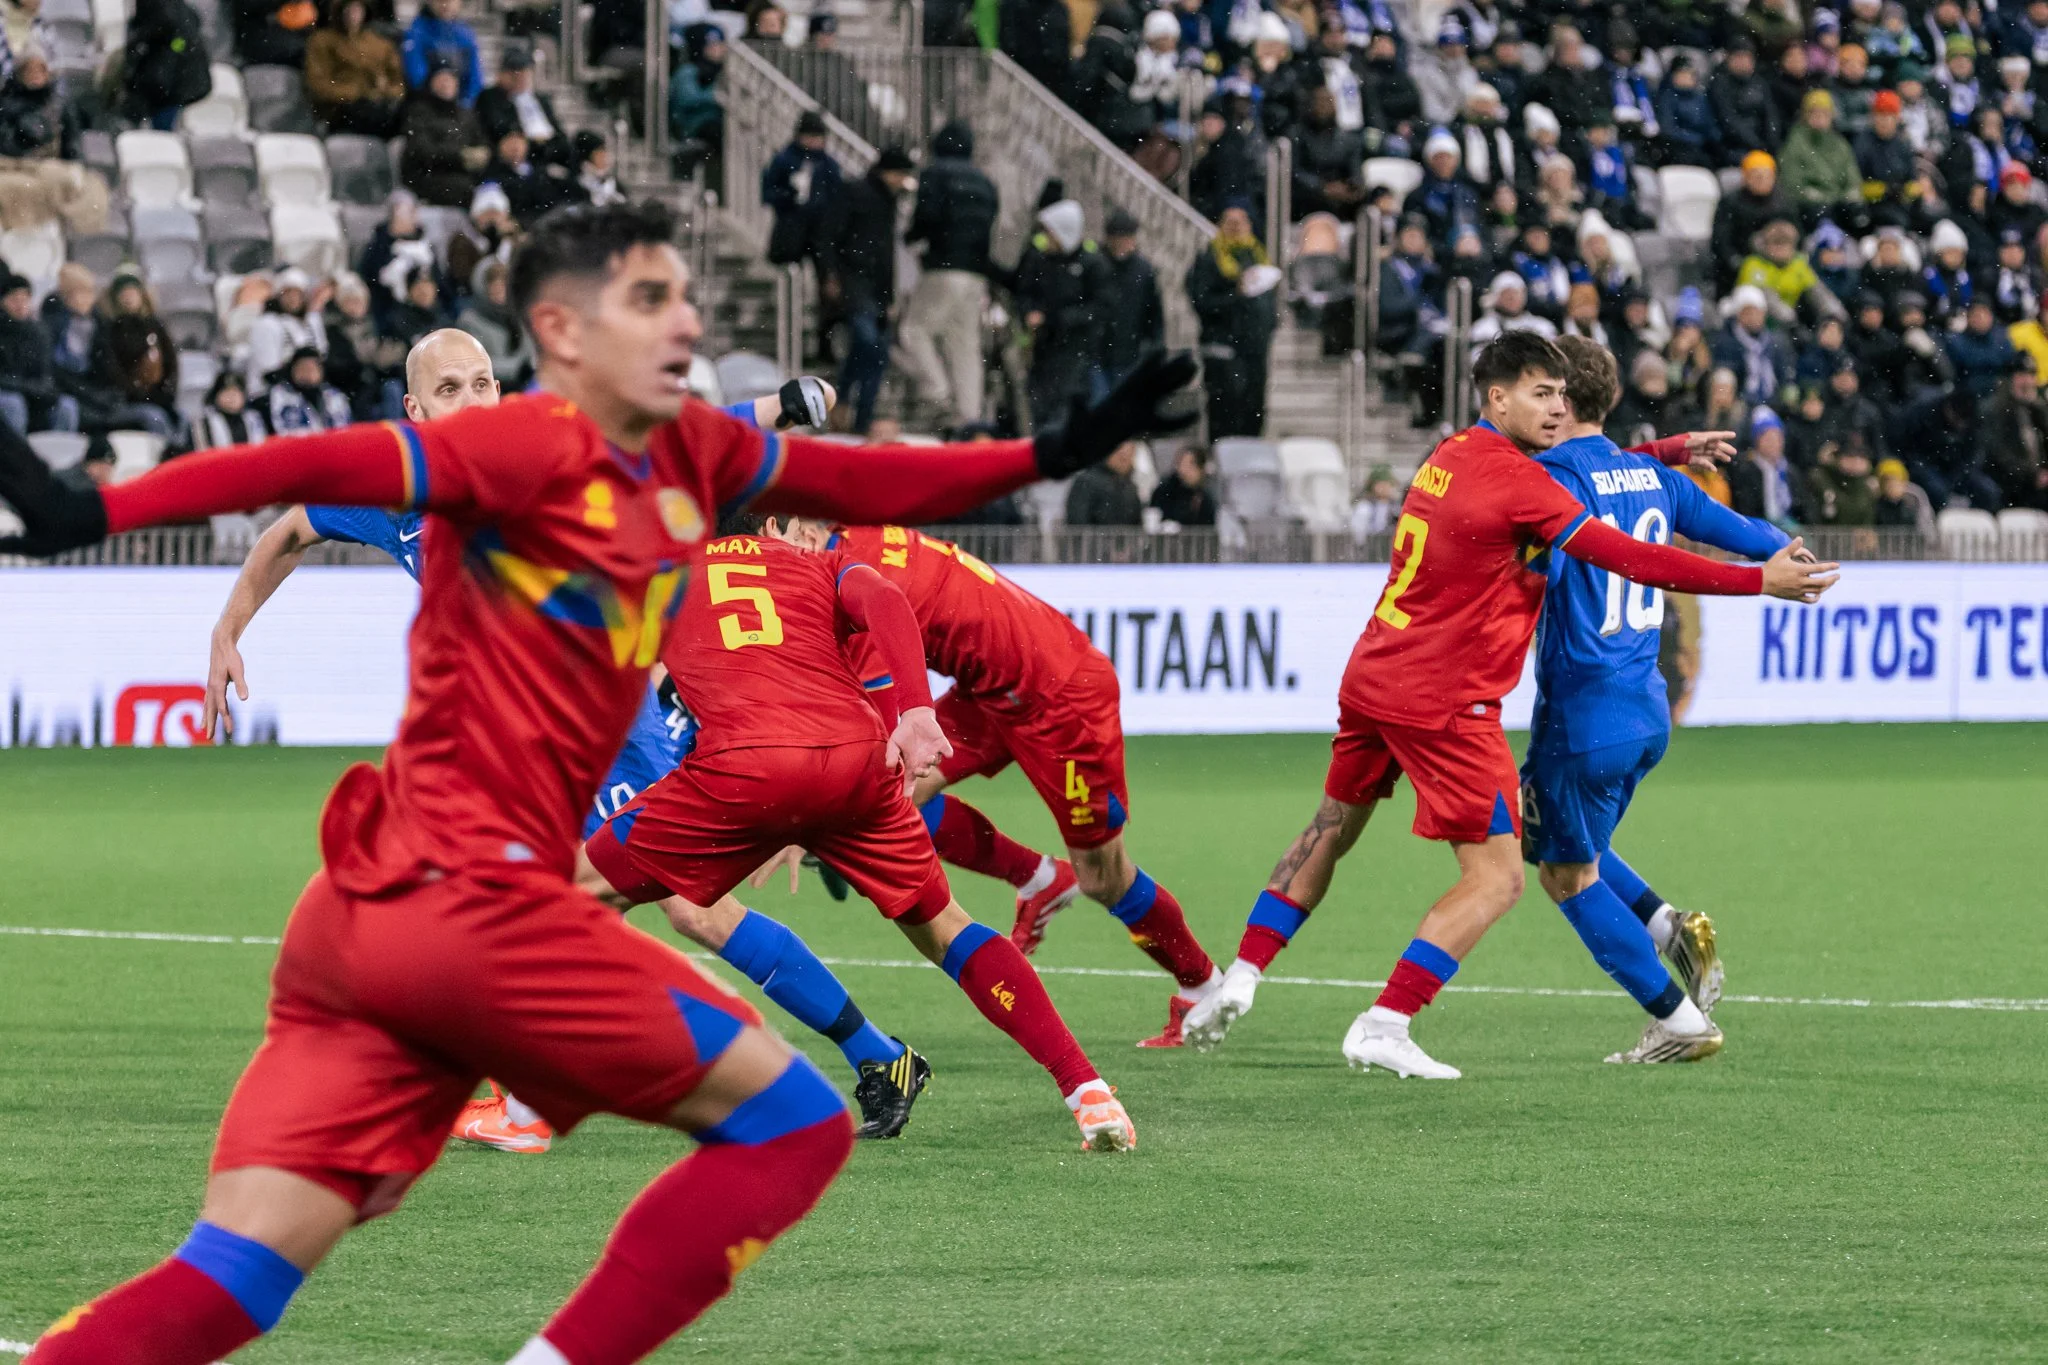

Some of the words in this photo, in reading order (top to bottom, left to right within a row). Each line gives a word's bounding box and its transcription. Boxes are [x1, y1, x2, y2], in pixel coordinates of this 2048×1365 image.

[706, 538, 762, 555] MAX
[1375, 512, 1429, 630] 2
[707, 563, 784, 650] 5
[1760, 605, 1938, 679] KIITOS
[1966, 605, 2048, 679] TE
[1066, 759, 1090, 804] 4
